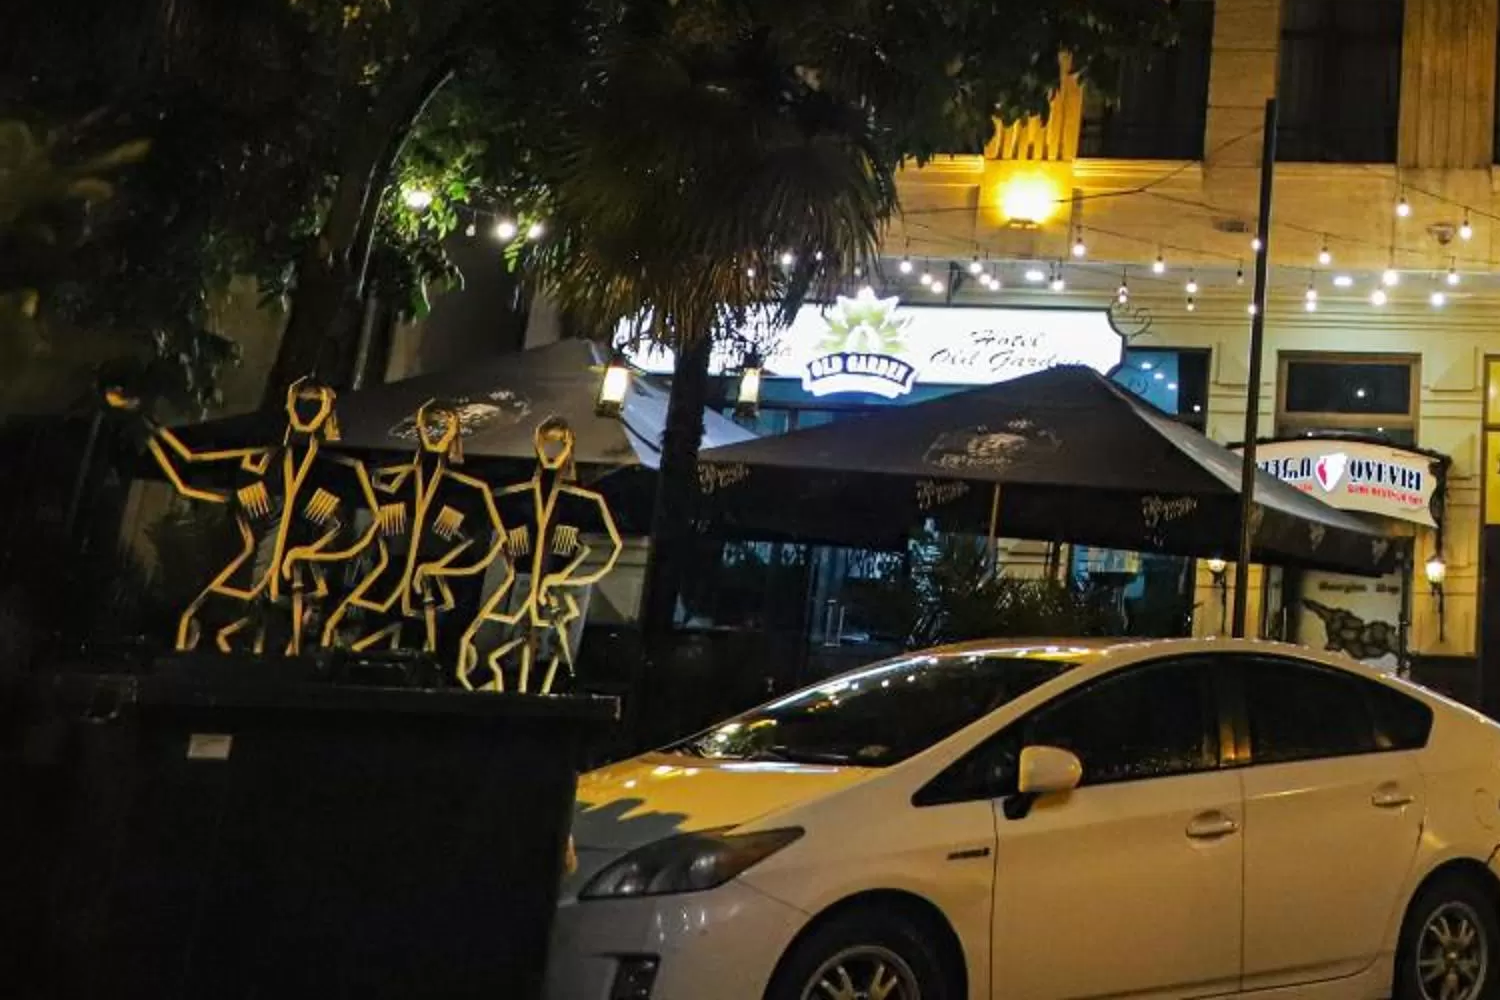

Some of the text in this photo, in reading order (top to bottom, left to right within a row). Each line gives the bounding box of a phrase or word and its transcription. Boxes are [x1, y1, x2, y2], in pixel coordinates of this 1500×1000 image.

[811, 355, 842, 377] OLD
[847, 355, 908, 382] GARDEN
[1350, 459, 1421, 491] QVEVRI
